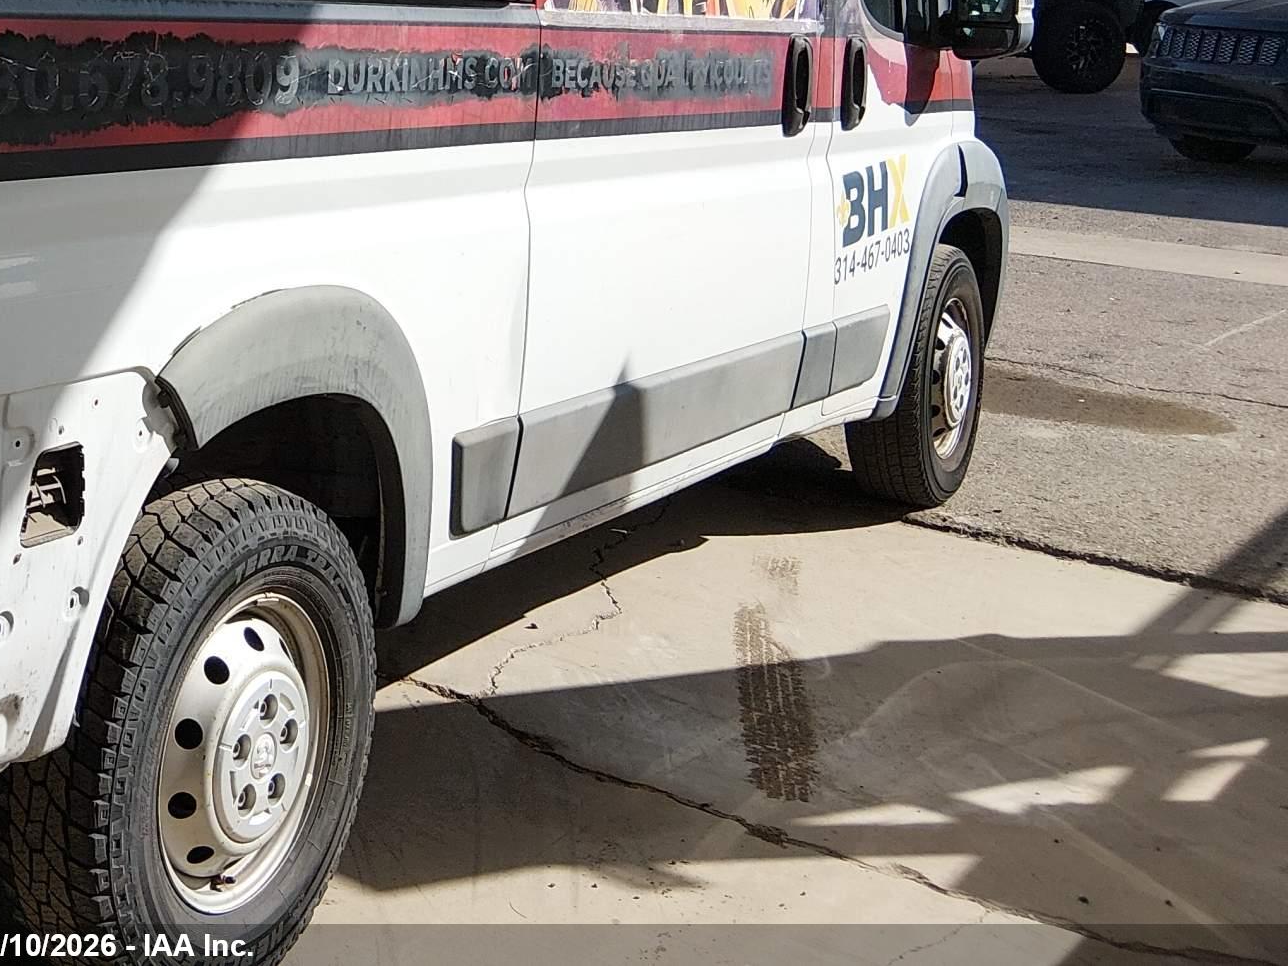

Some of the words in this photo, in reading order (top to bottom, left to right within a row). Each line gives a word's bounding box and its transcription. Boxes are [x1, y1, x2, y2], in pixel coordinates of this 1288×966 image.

[551, 57, 639, 89] BECAUSE
[842, 153, 910, 248] BHX
[834, 228, 910, 285] 314-467-0403
[235, 545, 299, 584] TERRA
